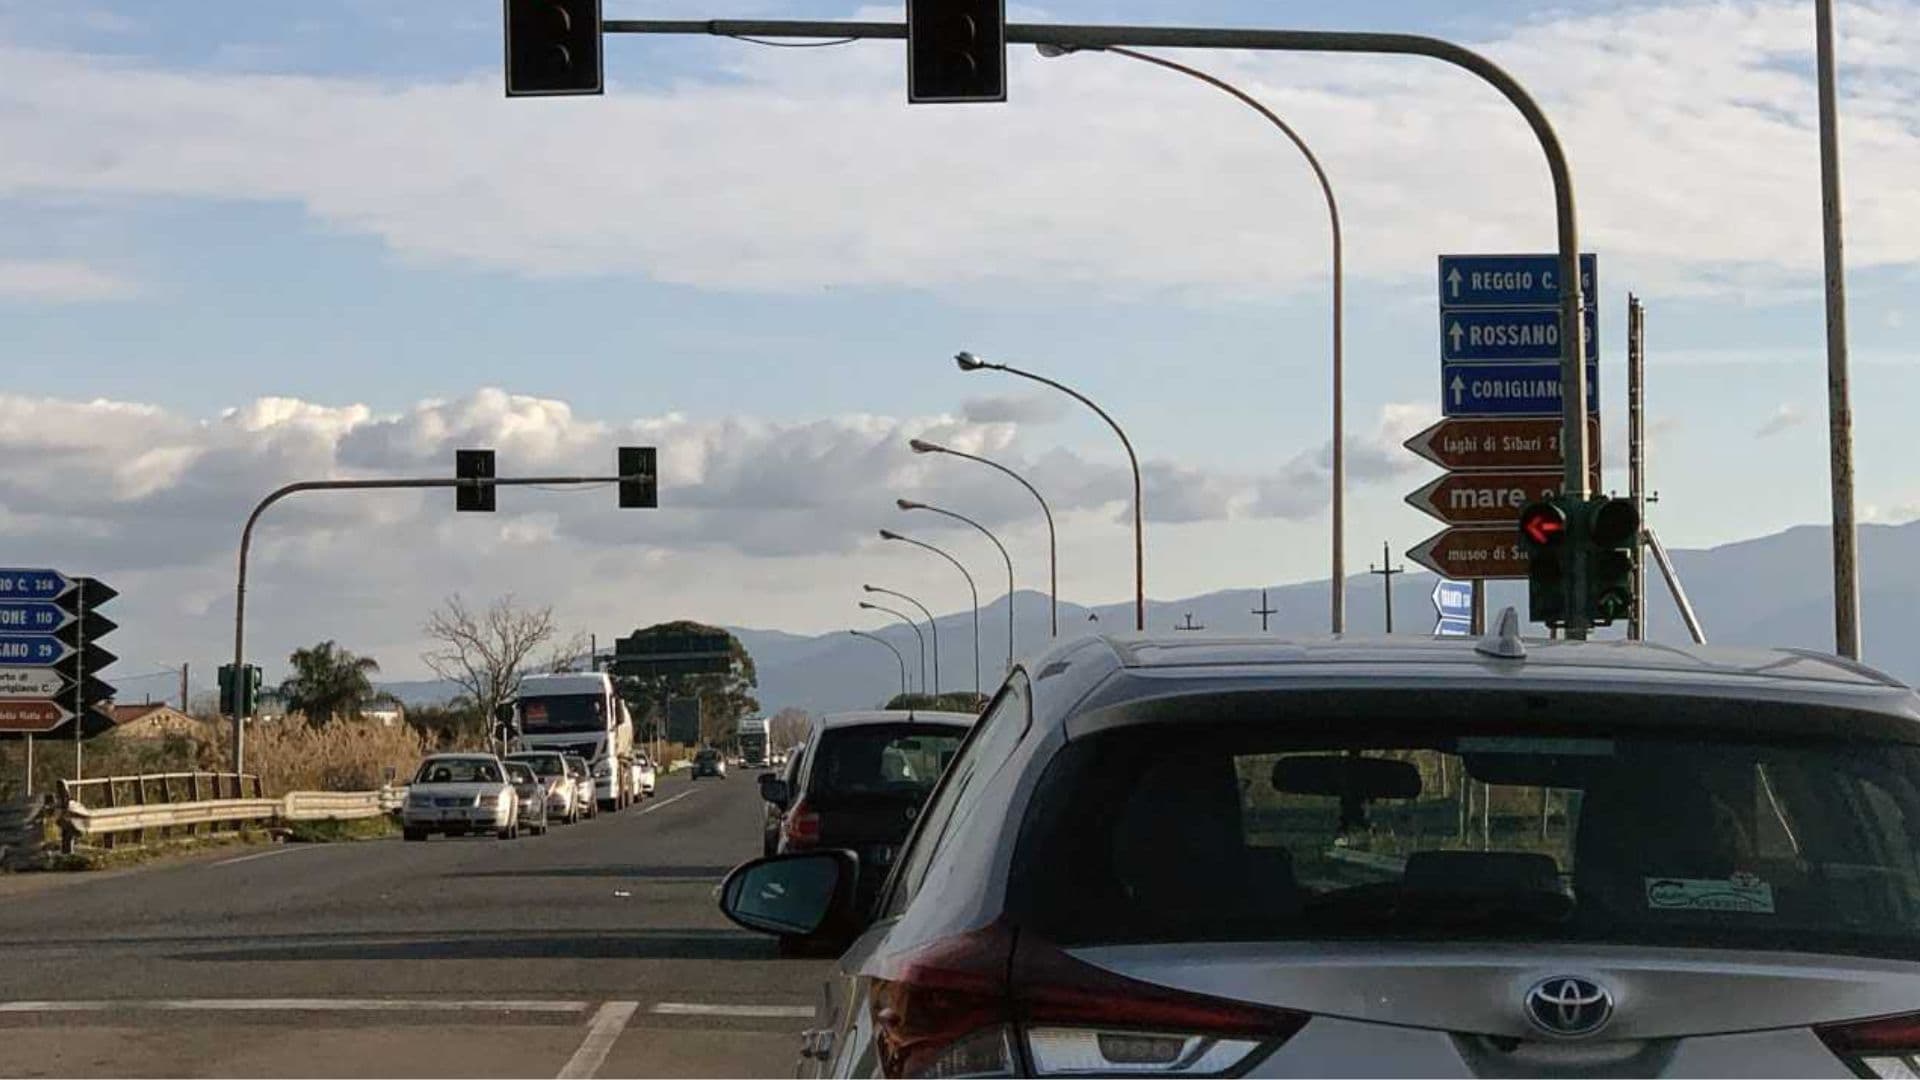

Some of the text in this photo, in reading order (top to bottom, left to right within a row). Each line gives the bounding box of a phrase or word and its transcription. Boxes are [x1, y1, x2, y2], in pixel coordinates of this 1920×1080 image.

[1471, 271, 1533, 290] REGGIO
[1541, 271, 1557, 289] C.
[1470, 325, 1558, 346] ROSSANO
[1483, 436, 1496, 451] di
[1503, 436, 1541, 451] Sibari
[1450, 488, 1526, 509] mare
[1448, 550, 1488, 561] museo
[1493, 547, 1505, 560] di
[39, 644, 53, 657] 29
